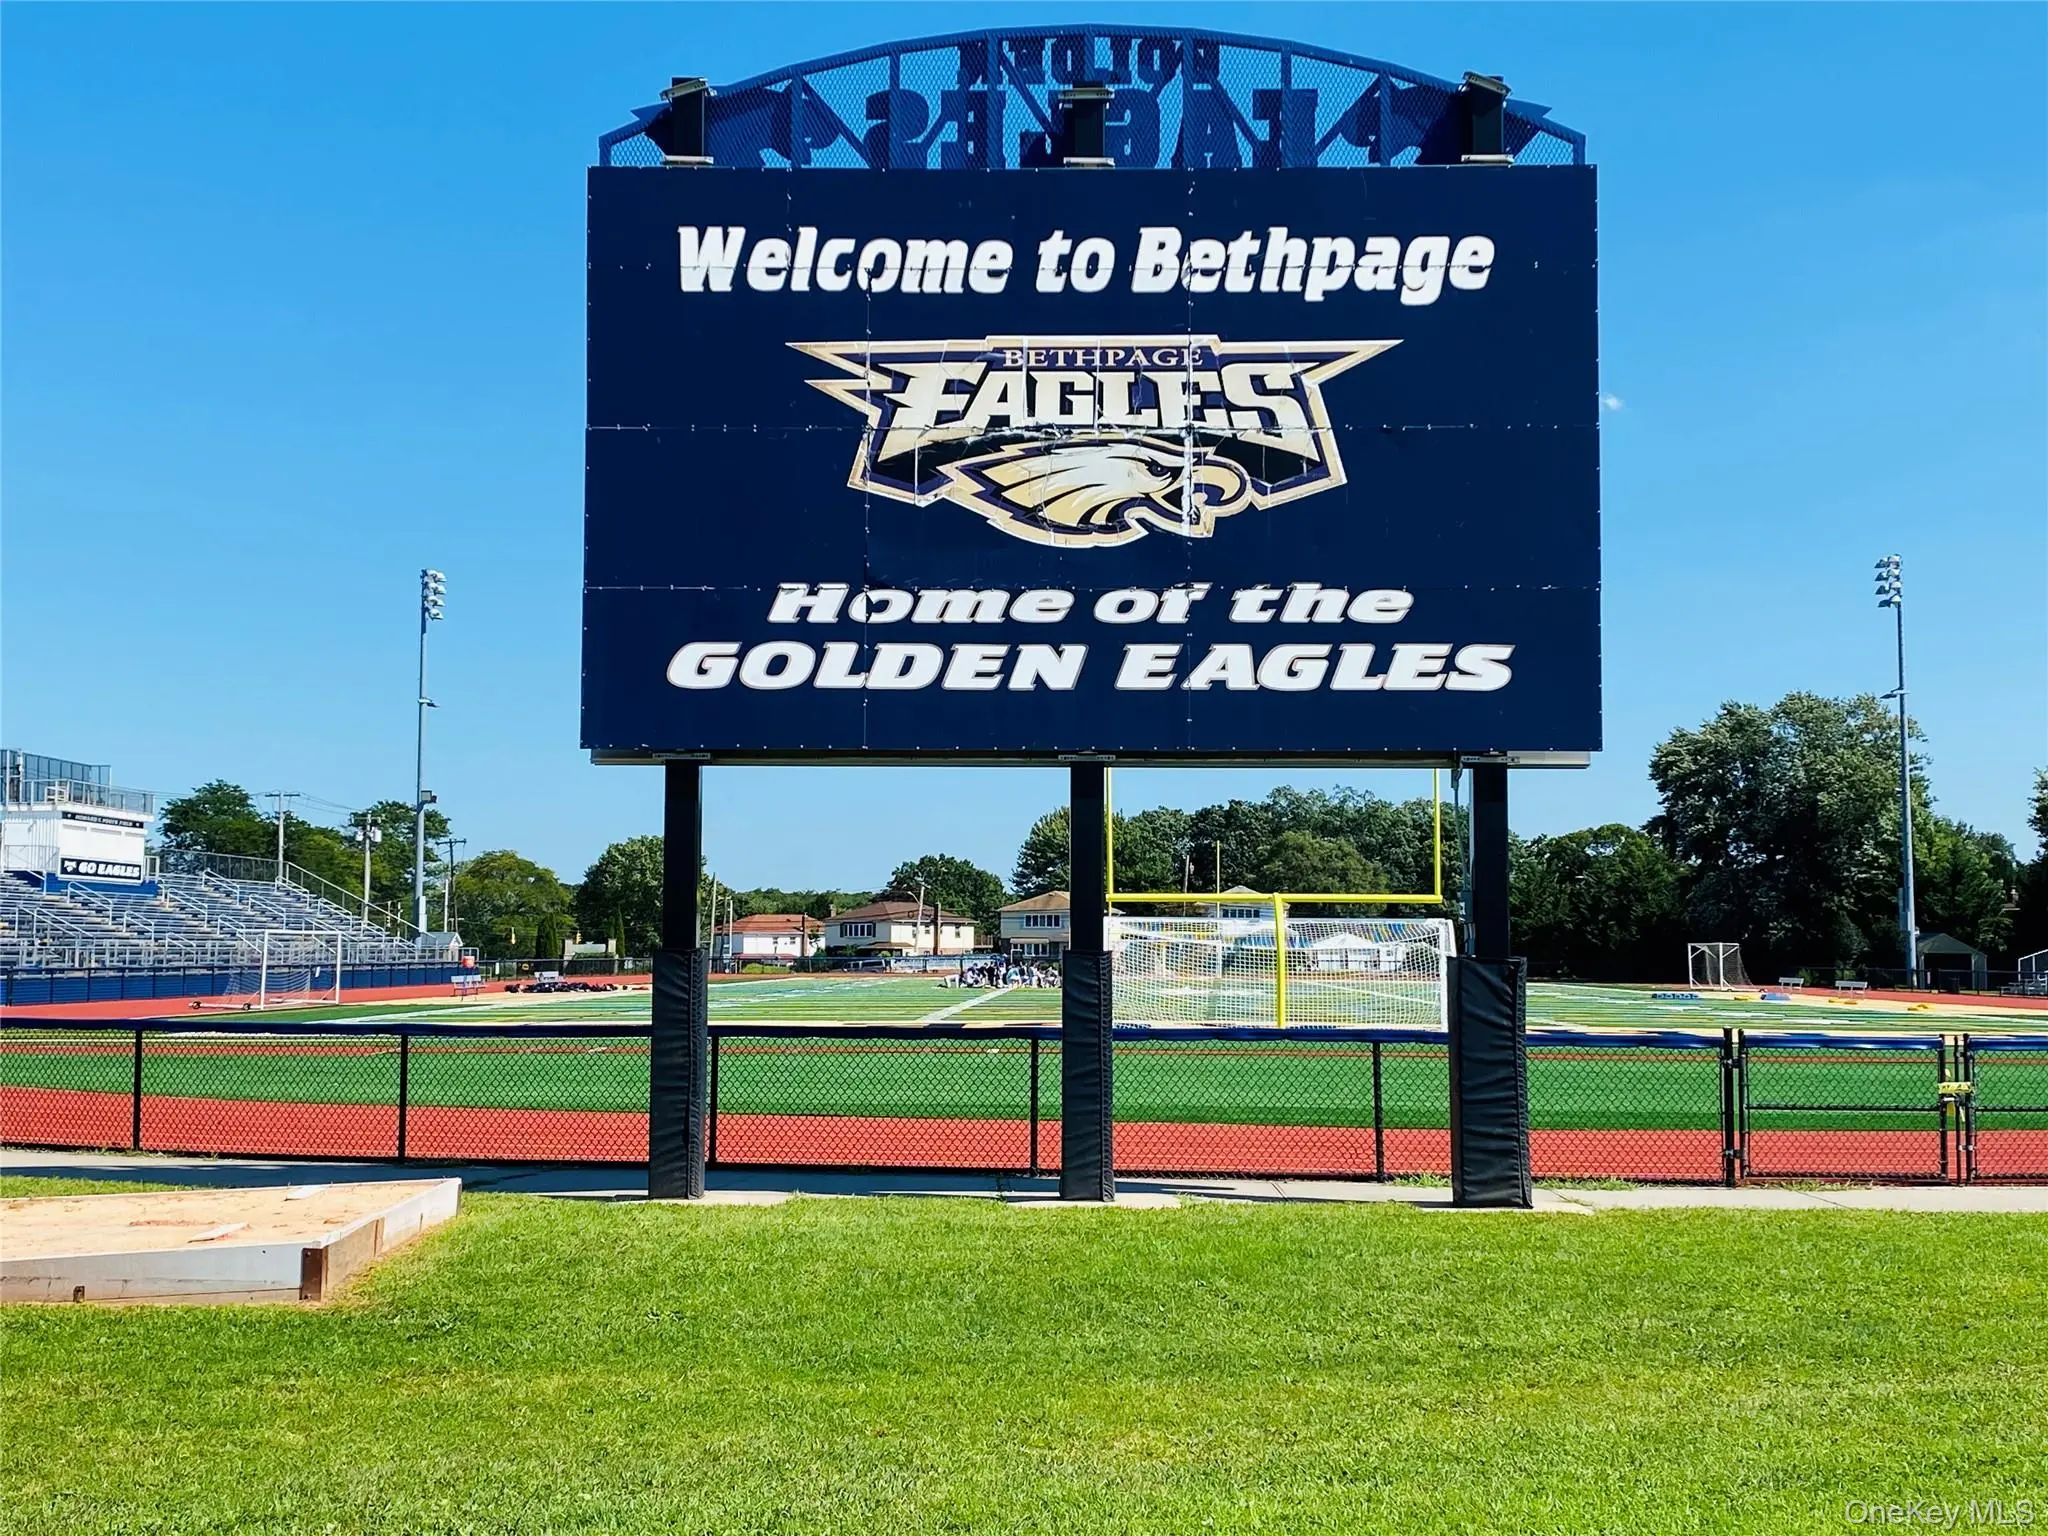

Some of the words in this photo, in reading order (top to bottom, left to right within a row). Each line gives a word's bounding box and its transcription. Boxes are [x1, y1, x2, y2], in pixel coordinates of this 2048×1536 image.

[677, 225, 1014, 294] Welcome
[1035, 229, 1116, 294] to
[1130, 226, 1496, 306] Bethpage
[1002, 347, 1204, 368] BETHPAGE
[874, 361, 1320, 461] EAGLES
[766, 582, 1075, 624] Home
[1093, 582, 1214, 624] of
[1228, 582, 1415, 624] the
[666, 640, 1090, 691] GOLDEN
[1113, 642, 1517, 692] EAGLES
[78, 861, 97, 875] GO
[97, 863, 140, 877] EAGLES
